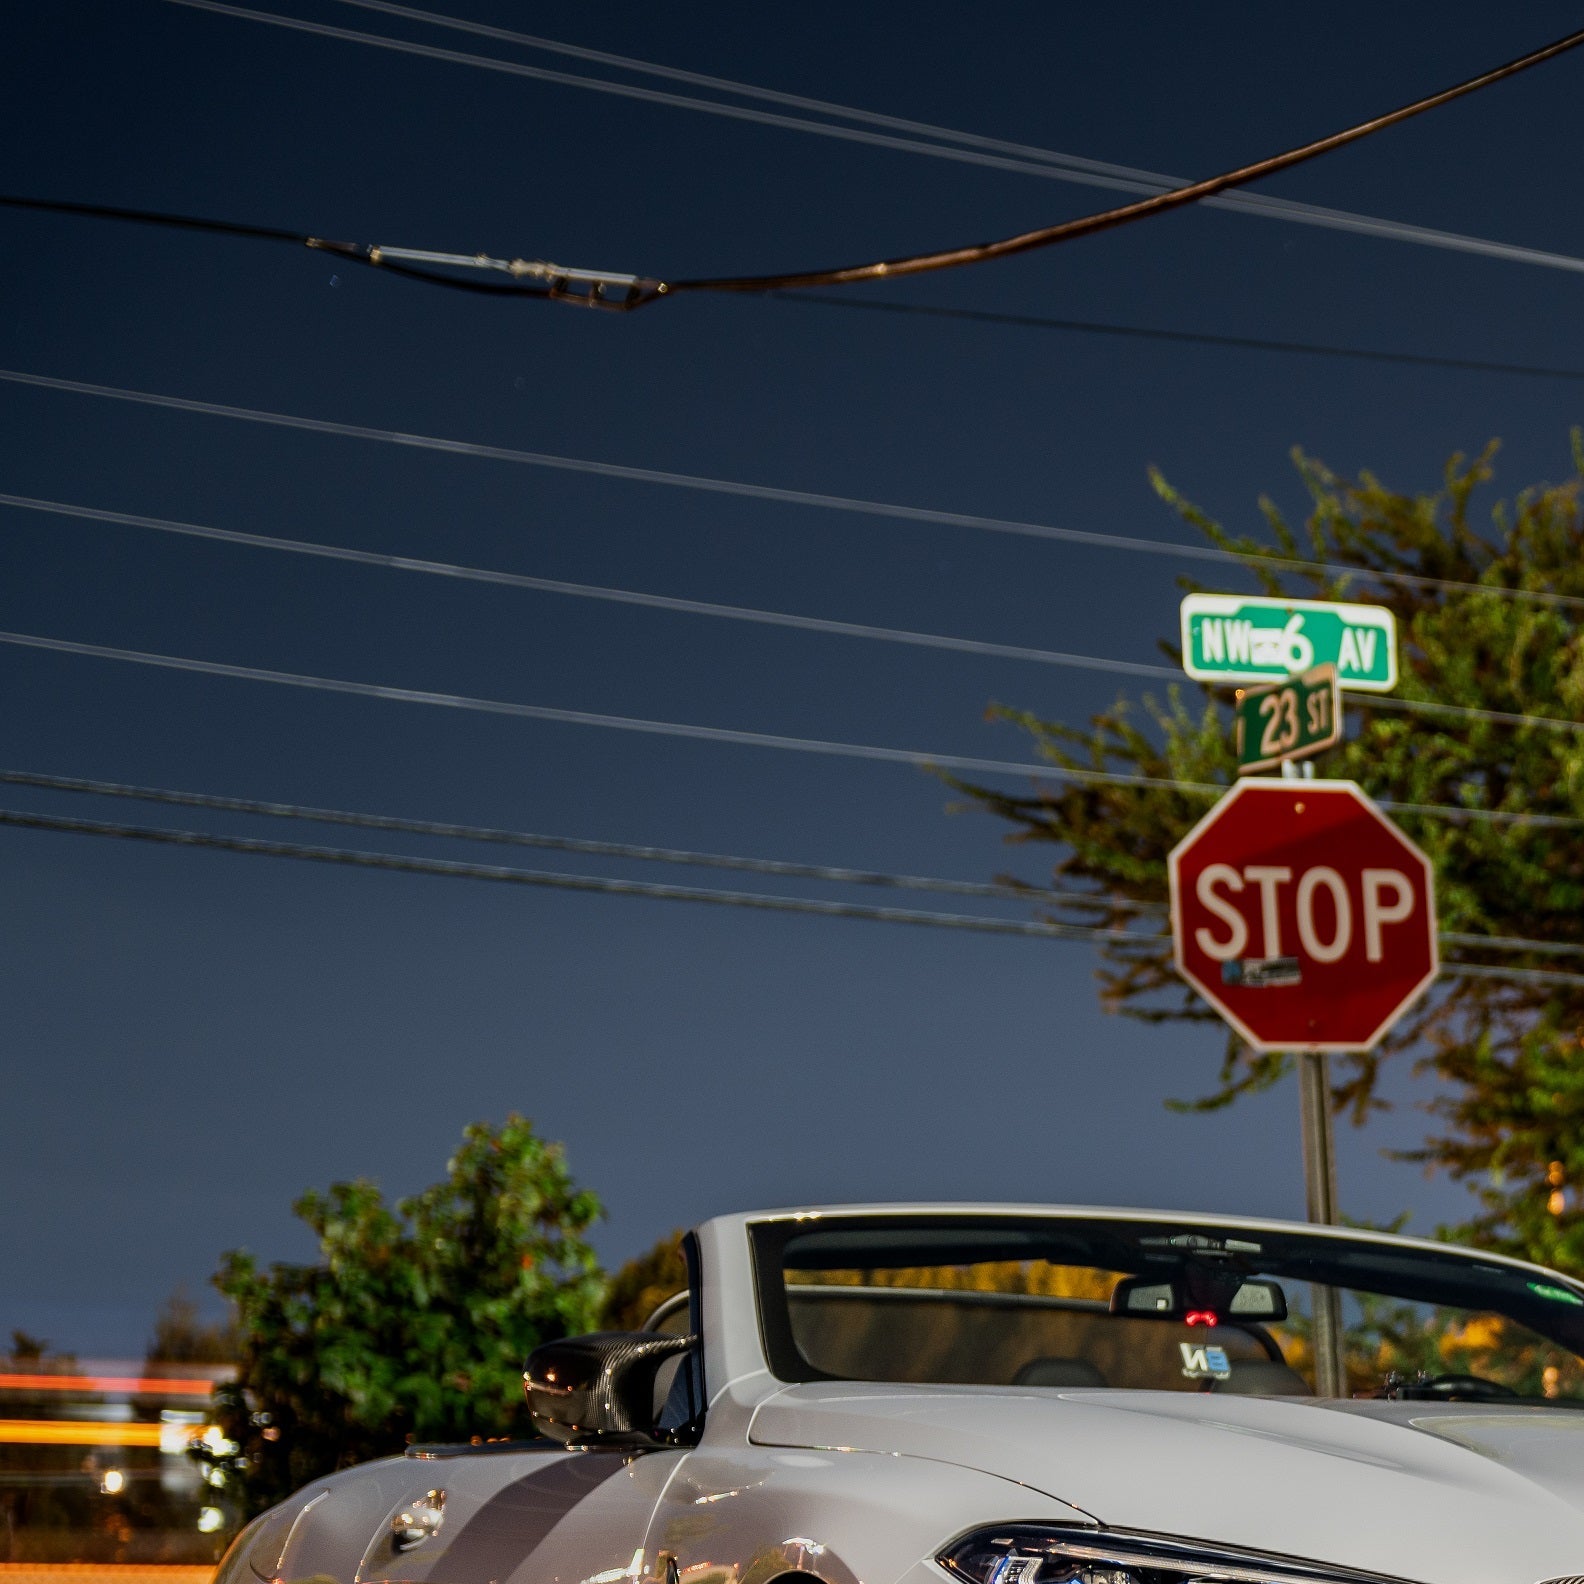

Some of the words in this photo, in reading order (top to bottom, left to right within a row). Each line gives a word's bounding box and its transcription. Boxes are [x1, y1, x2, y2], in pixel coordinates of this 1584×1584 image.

[1201, 617, 1251, 665] NW
[1282, 613, 1315, 673] 6
[1337, 626, 1378, 674] AV
[1259, 688, 1300, 757] 23
[1306, 687, 1330, 736] ST
[1195, 863, 1416, 964] STOP
